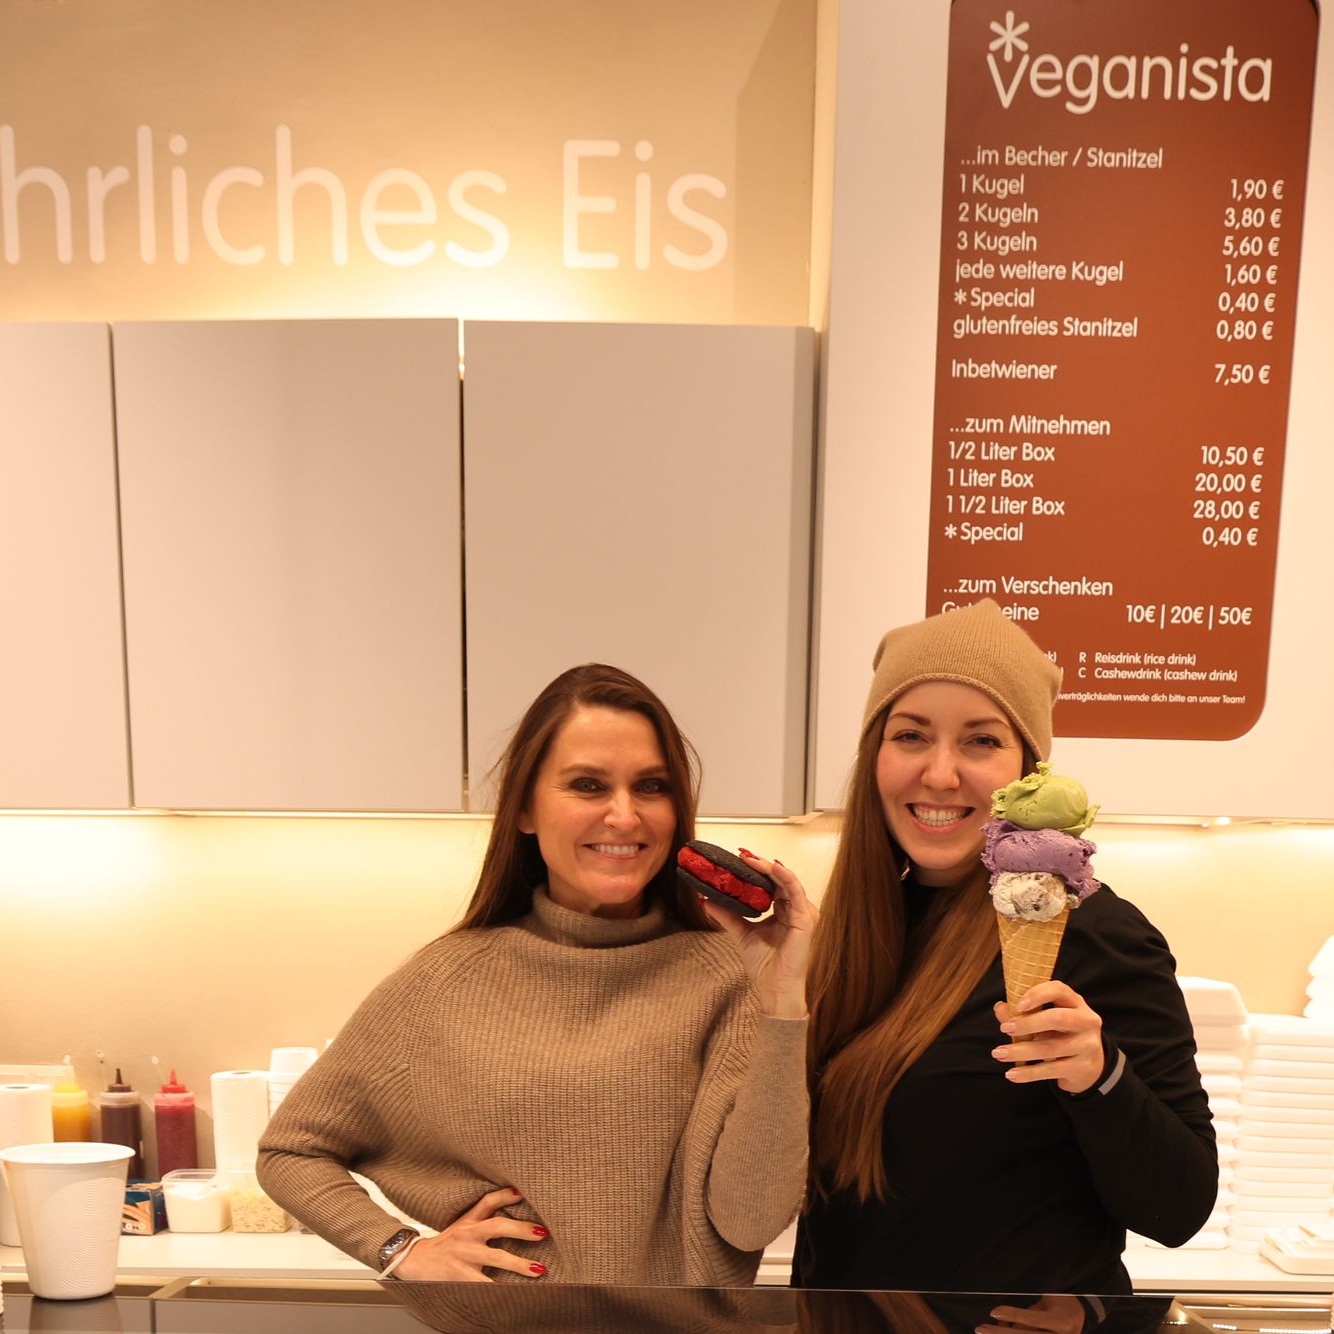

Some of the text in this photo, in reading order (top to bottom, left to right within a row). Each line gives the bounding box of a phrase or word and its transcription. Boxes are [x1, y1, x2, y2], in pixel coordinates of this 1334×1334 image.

[1005, 146, 1067, 168] Becher
[1072, 147, 1082, 167] /
[1087, 147, 1163, 169] Stanitzel
[959, 174, 1284, 202] 1 Kugel 1,90 €
[563, 140, 729, 271] Eis
[958, 203, 1282, 230] 2 Kugeln 3,80 €
[957, 231, 1280, 258] 3 Kugeln 5,60 €
[955, 260, 1278, 287] jede weitere Kugel 1,60 €
[970, 288, 1276, 314] Special 0,40 €
[953, 315, 1274, 343] glutenfreies Stanitzel 0,80 €
[952, 359, 1271, 386] Inbetwiener 7,50 €
[1008, 415, 1111, 436] Mitnehmen
[948, 441, 1265, 468] 1/2 Liter Box 10,50 €
[947, 468, 1263, 495] 1 Liter Box 20,00 €
[946, 495, 1261, 522] 1 1/2 Liter Box 28,00 €
[960, 523, 1259, 548] Special 0,40 €
[1001, 576, 1114, 596] Verschenken
[1126, 605, 1156, 623] 10€
[1170, 605, 1204, 624] 20€
[1218, 606, 1252, 625] 50€
[1079, 651, 1197, 666] R Reisdrink (rice drink)
[1078, 667, 1238, 682] C Cashewdrink (cashew drink)
[1151, 693, 1167, 703] dich
[1169, 694, 1186, 703] bitte
[1187, 695, 1198, 703] an
